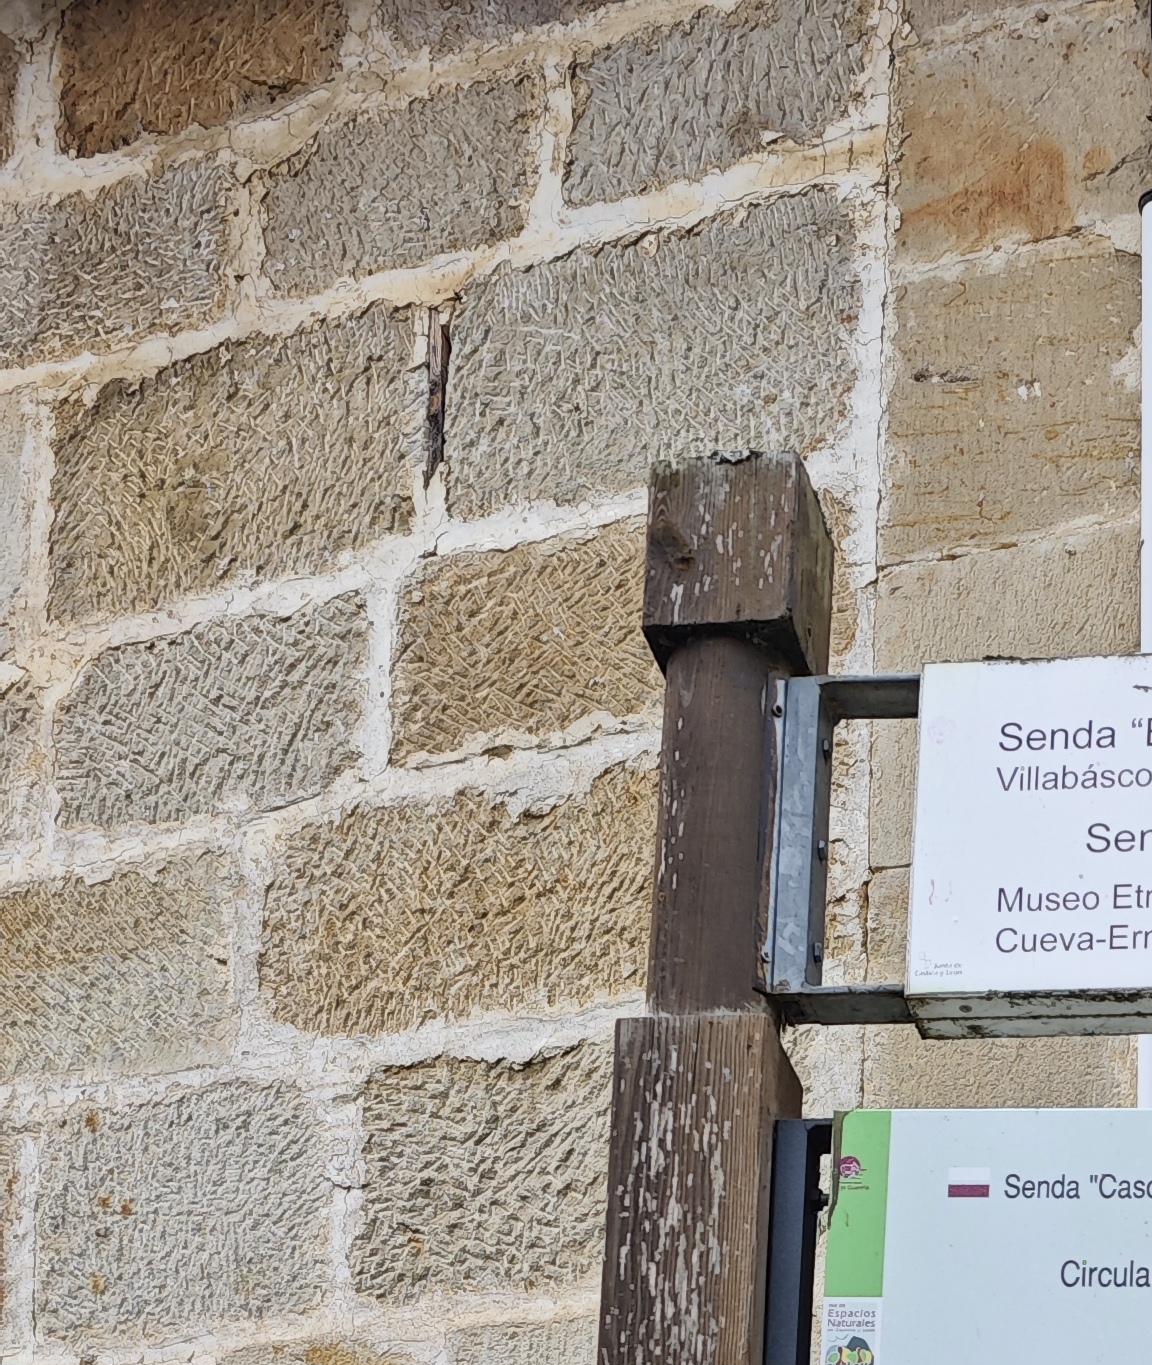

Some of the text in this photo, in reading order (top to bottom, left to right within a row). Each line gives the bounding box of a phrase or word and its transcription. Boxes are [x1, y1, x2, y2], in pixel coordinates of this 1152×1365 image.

[998, 719, 1116, 752] Senda
[997, 886, 1100, 913] Museo
[1003, 1173, 1081, 1200] Senda
[827, 1309, 876, 1320] Espacios
[827, 1318, 876, 1328] Naturales
